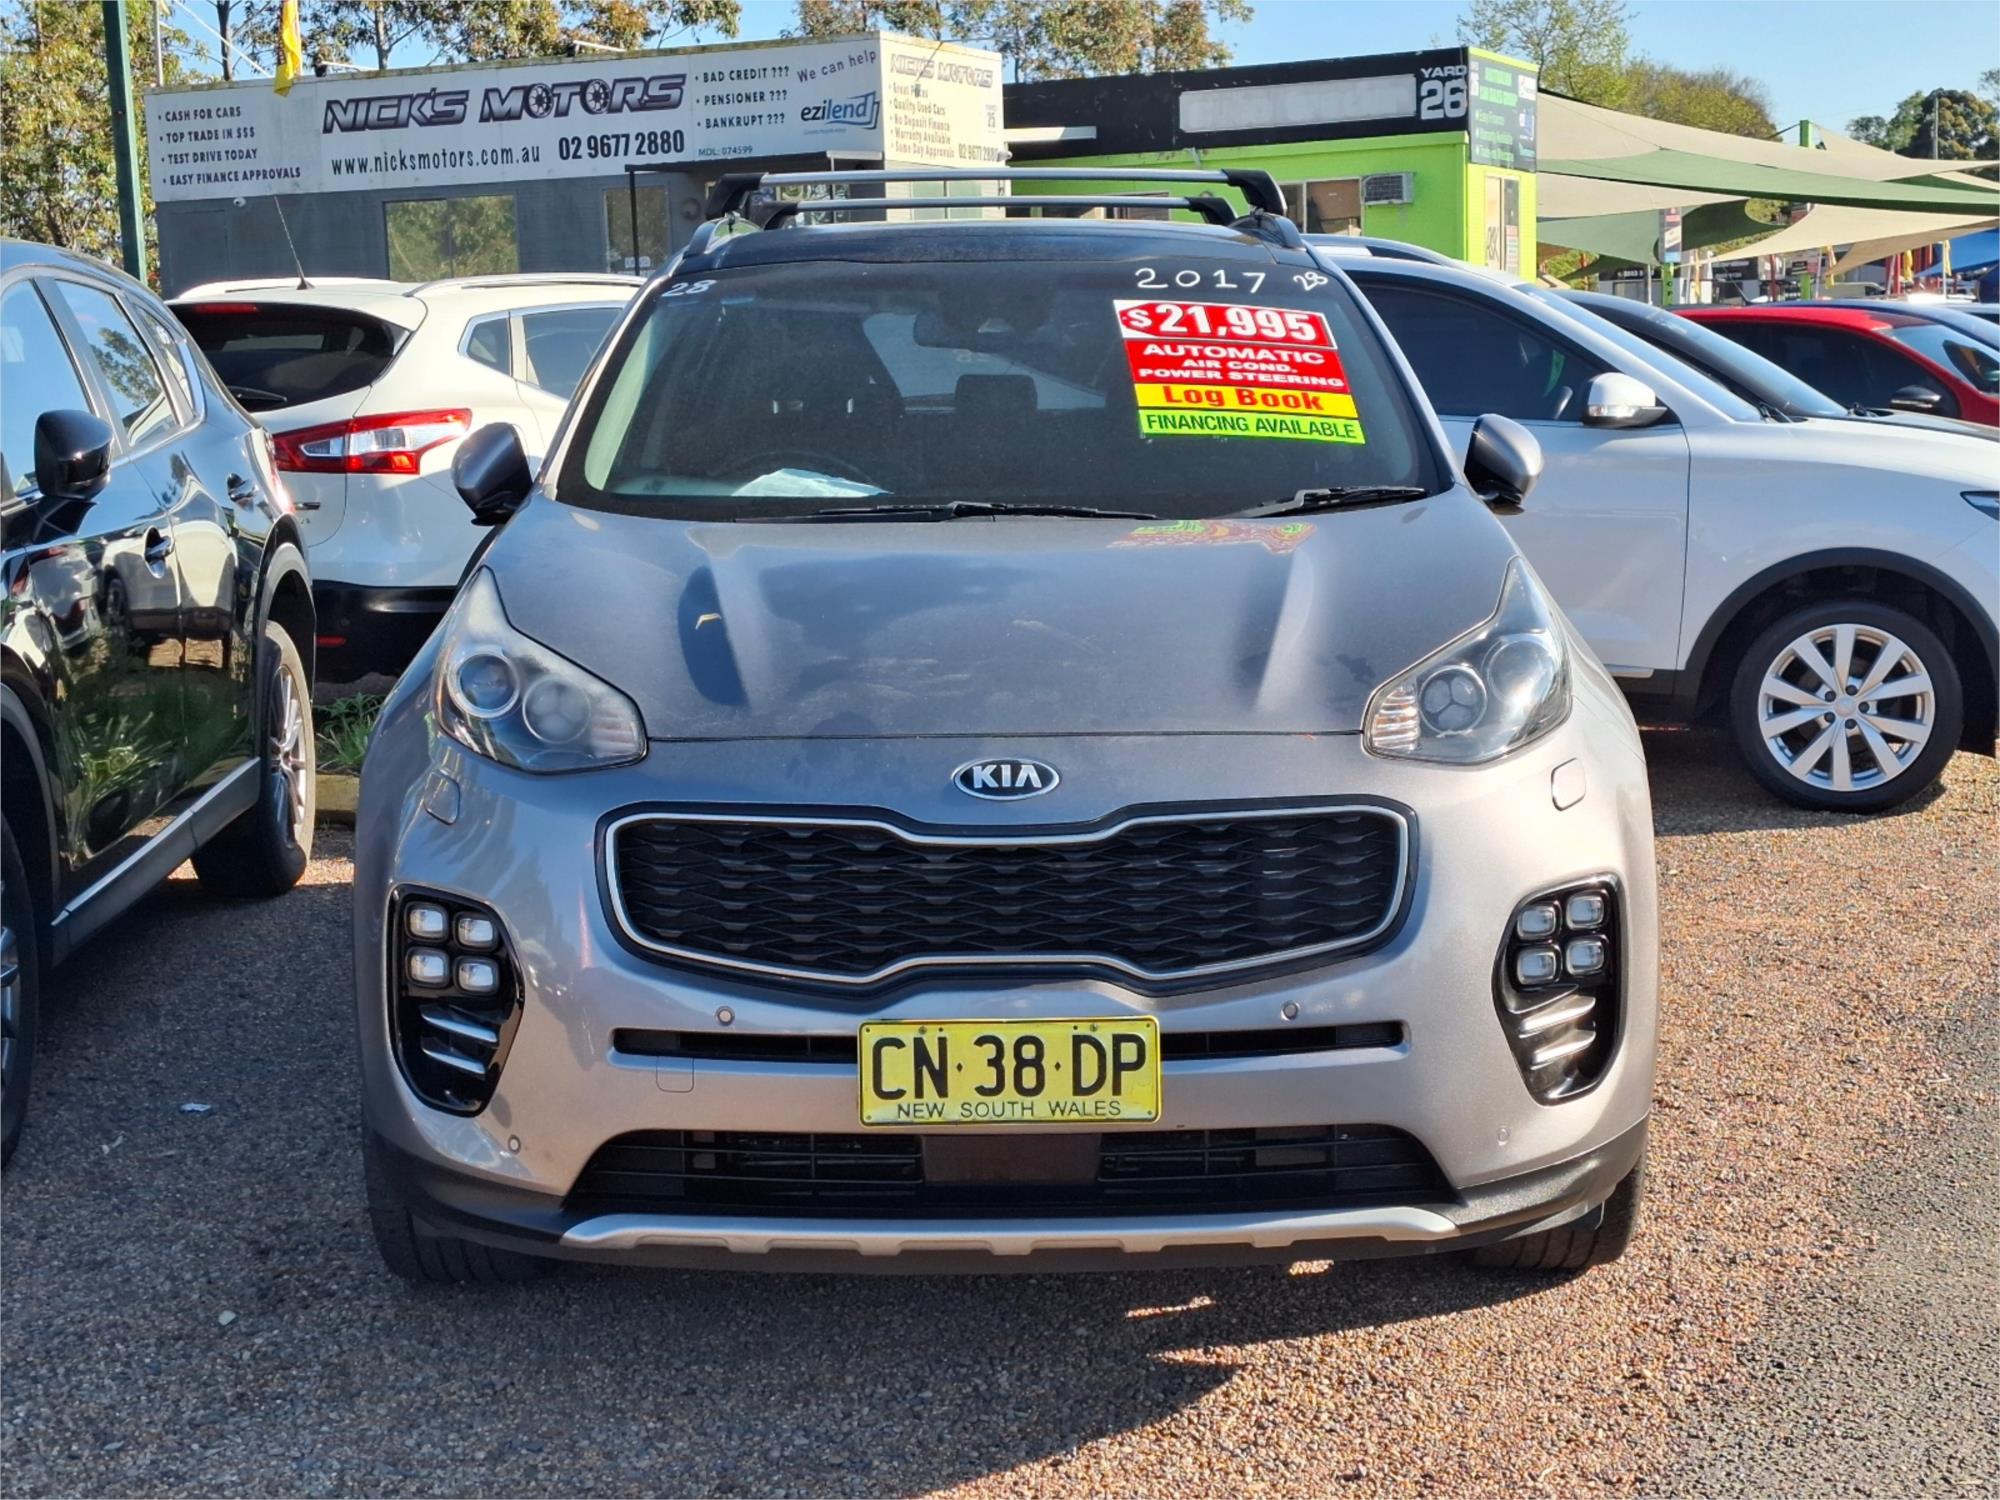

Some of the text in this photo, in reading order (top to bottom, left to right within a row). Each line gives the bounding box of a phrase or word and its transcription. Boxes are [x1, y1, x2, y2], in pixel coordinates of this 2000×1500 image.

[703, 65, 790, 83] BAD CREDIT ???
[796, 49, 877, 83] We can help
[1420, 65, 1468, 78] YARD
[322, 73, 688, 134] NICK'S MOTORS
[704, 89, 788, 106] PENSIONER ???
[800, 95, 870, 121] ezilend
[1420, 79, 1468, 120] 26
[165, 106, 241, 123] CASH FOR CARS
[705, 112, 785, 129] BANKRUPT ???
[166, 132, 185, 144] TOP
[188, 129, 219, 143] TRADE
[223, 127, 233, 140] IN
[558, 129, 685, 161] 02 9677 2880
[168, 148, 258, 165] TEST DRIVE TODAY
[331, 144, 541, 176] www.nicksmotors.com.au
[722, 145, 753, 156] 074599
[170, 167, 301, 186] EASY FINANCE APPROVALS
[1134, 267, 1266, 294] 2017
[1124, 302, 1318, 342] $21,995
[1142, 343, 1325, 365] AUTOMATIC
[1182, 358, 1299, 374] AIR COND.
[1138, 367, 1345, 388] POWER STEERING
[1162, 385, 1325, 411] Log Book
[1146, 413, 1358, 440] FINANCING AVAILABLE
[972, 764, 1042, 789] KIA
[872, 1033, 1147, 1101] CN 38 DP
[897, 1100, 1121, 1119] NEW SOUTH WALES
